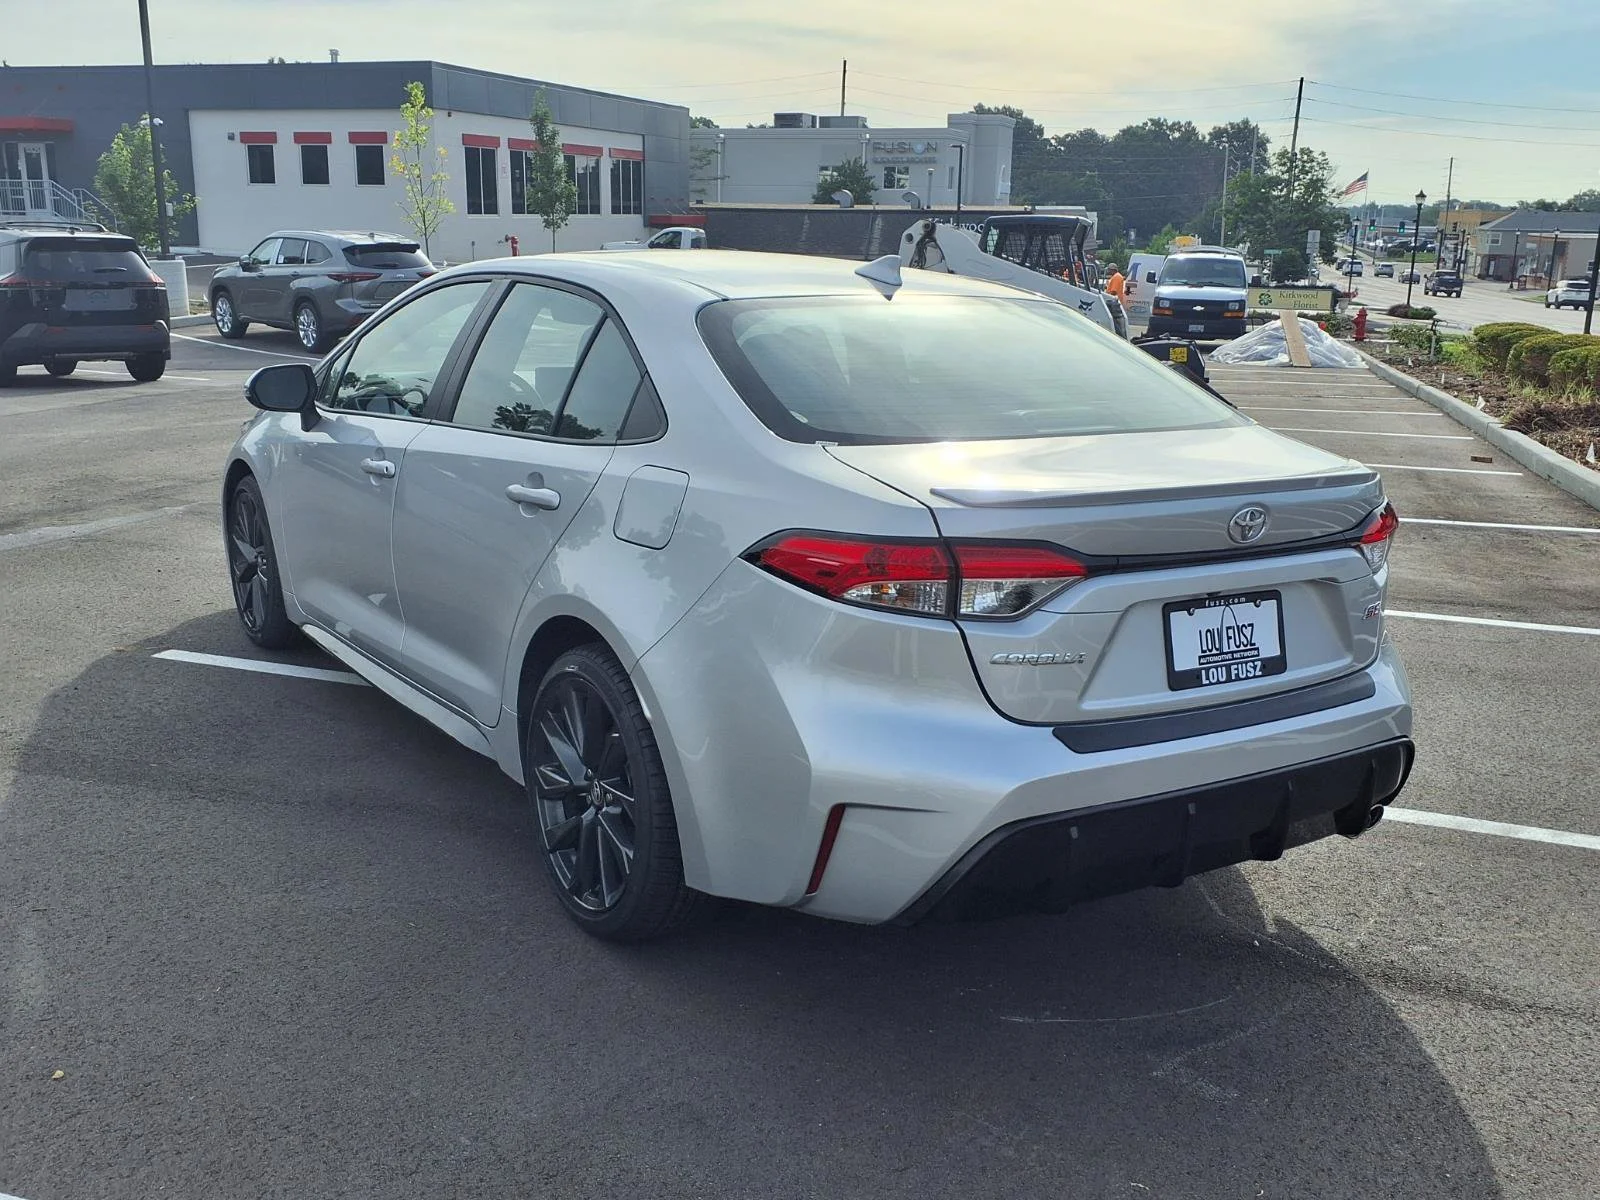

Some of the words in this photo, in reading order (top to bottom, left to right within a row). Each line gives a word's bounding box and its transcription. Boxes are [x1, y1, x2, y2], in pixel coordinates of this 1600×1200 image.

[1279, 290, 1319, 299] Kirkwood
[1293, 301, 1319, 309] Florist
[1205, 597, 1246, 607] fusz.com
[1199, 628, 1220, 654] LOU
[1226, 623, 1256, 650] FUSZ
[1200, 654, 1232, 664] AUTOMOTIVE
[1233, 650, 1259, 659] NETWORK
[1201, 666, 1226, 684] LOU
[1230, 661, 1262, 680] FUSZ
